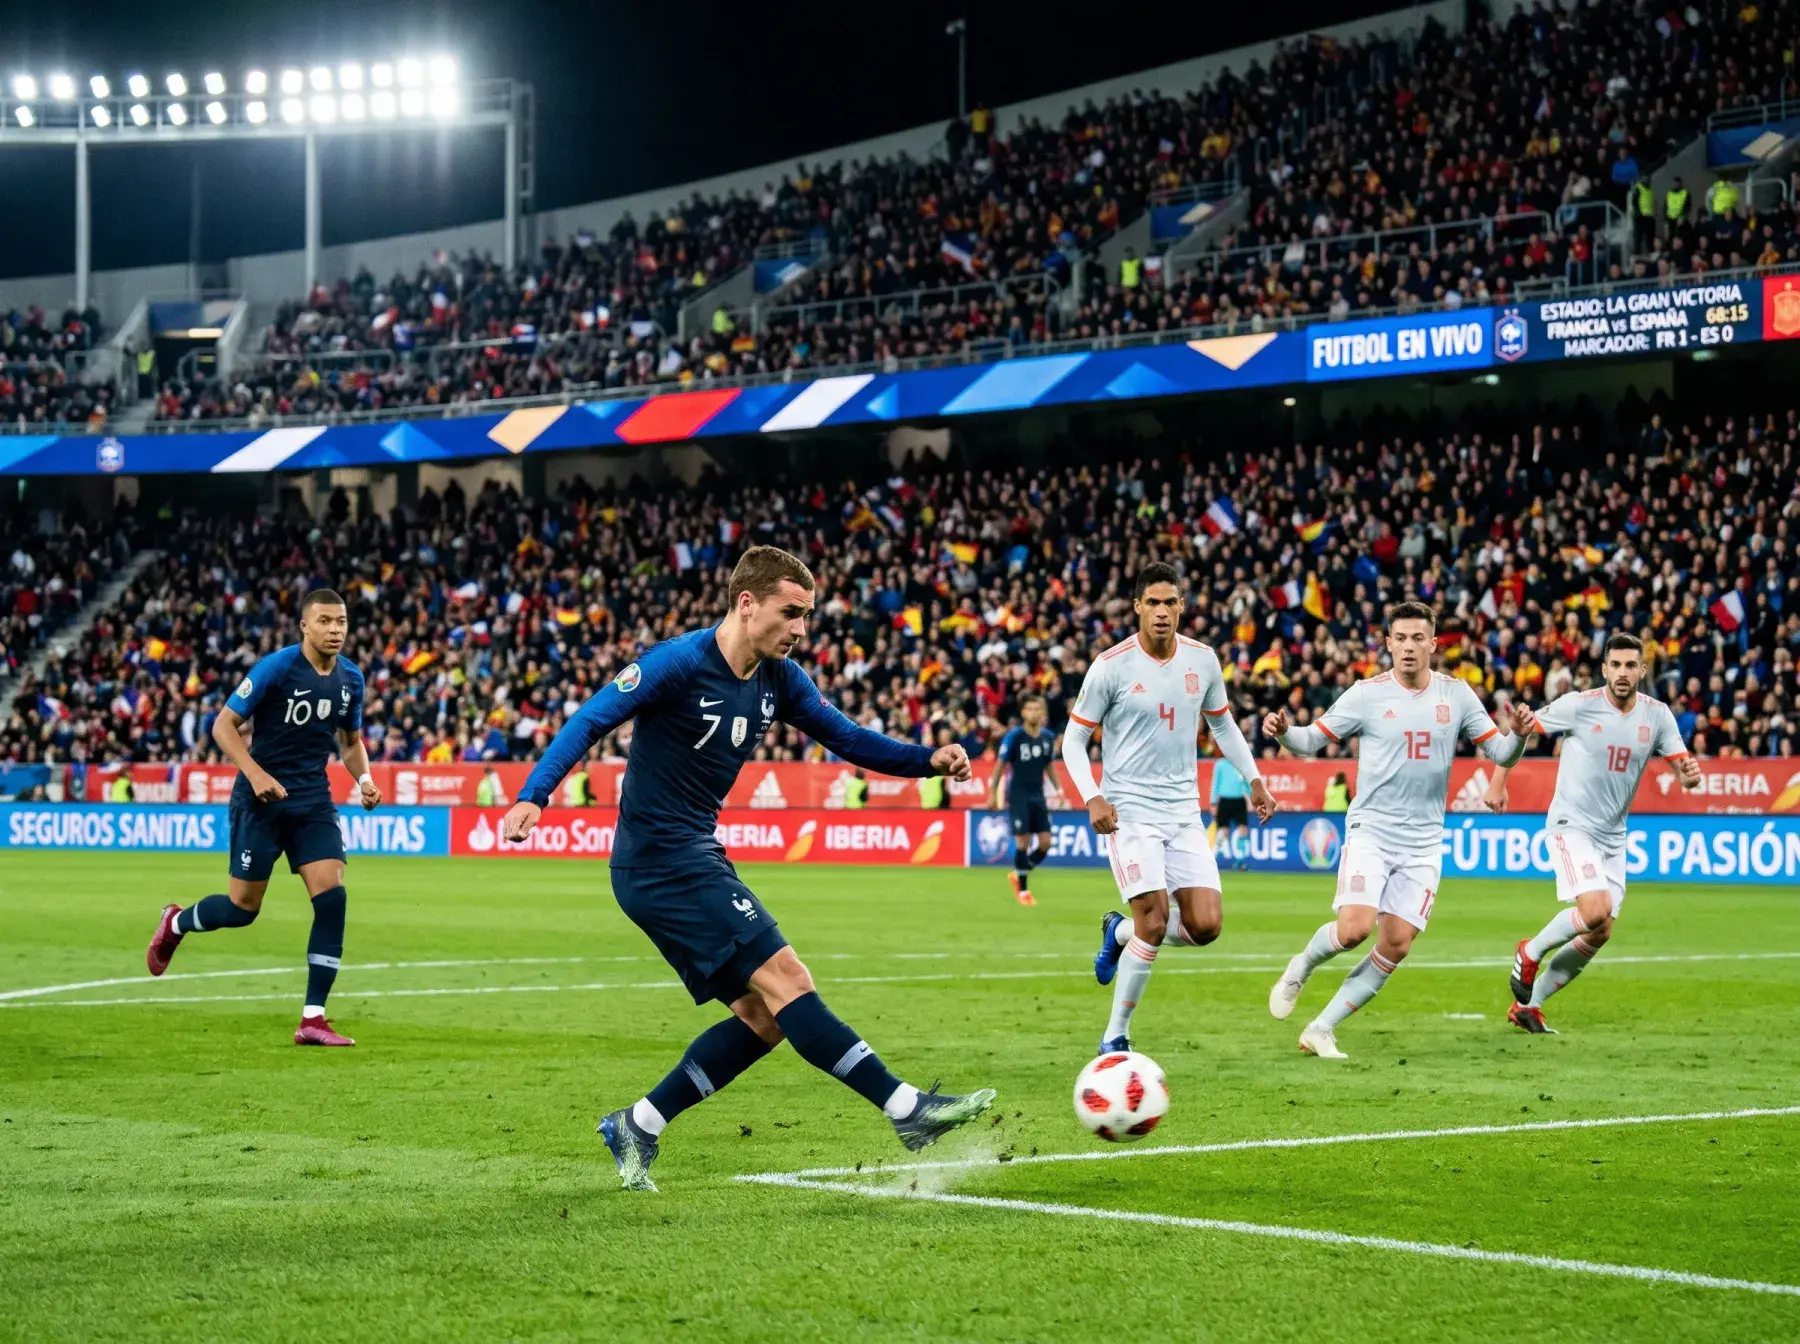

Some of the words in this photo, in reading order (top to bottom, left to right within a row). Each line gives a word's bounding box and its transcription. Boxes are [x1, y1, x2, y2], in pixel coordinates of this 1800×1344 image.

[1541, 299, 1604, 321] ESTADIO:
[1606, 296, 1627, 315] LA
[1628, 292, 1670, 312] GRAN
[1672, 284, 1742, 307] VICTORIA
[1547, 317, 1610, 340] FRANCIA
[1630, 307, 1688, 332] ESPAÑA
[1313, 332, 1394, 368] FUTBOL
[1397, 328, 1426, 360] EN
[1430, 322, 1483, 357] VIVO
[1564, 333, 1650, 357] MARCADOR:
[1656, 330, 1676, 349] FR
[1678, 329, 1688, 347] 1
[1700, 326, 1720, 344] ES
[284, 698, 312, 726] 10
[1158, 702, 1175, 731] 4
[693, 713, 721, 750] 7
[1403, 730, 1431, 760] 12
[1607, 744, 1631, 772] 18
[1681, 773, 1771, 796] BERIA
[9, 811, 115, 846] SEGUROS
[118, 812, 216, 847] SANITAS
[337, 814, 425, 852] ANITAS
[570, 818, 615, 852] San
[713, 823, 785, 848] BERIA
[825, 824, 910, 850] IBERIA
[1214, 827, 1288, 860] AGUE
